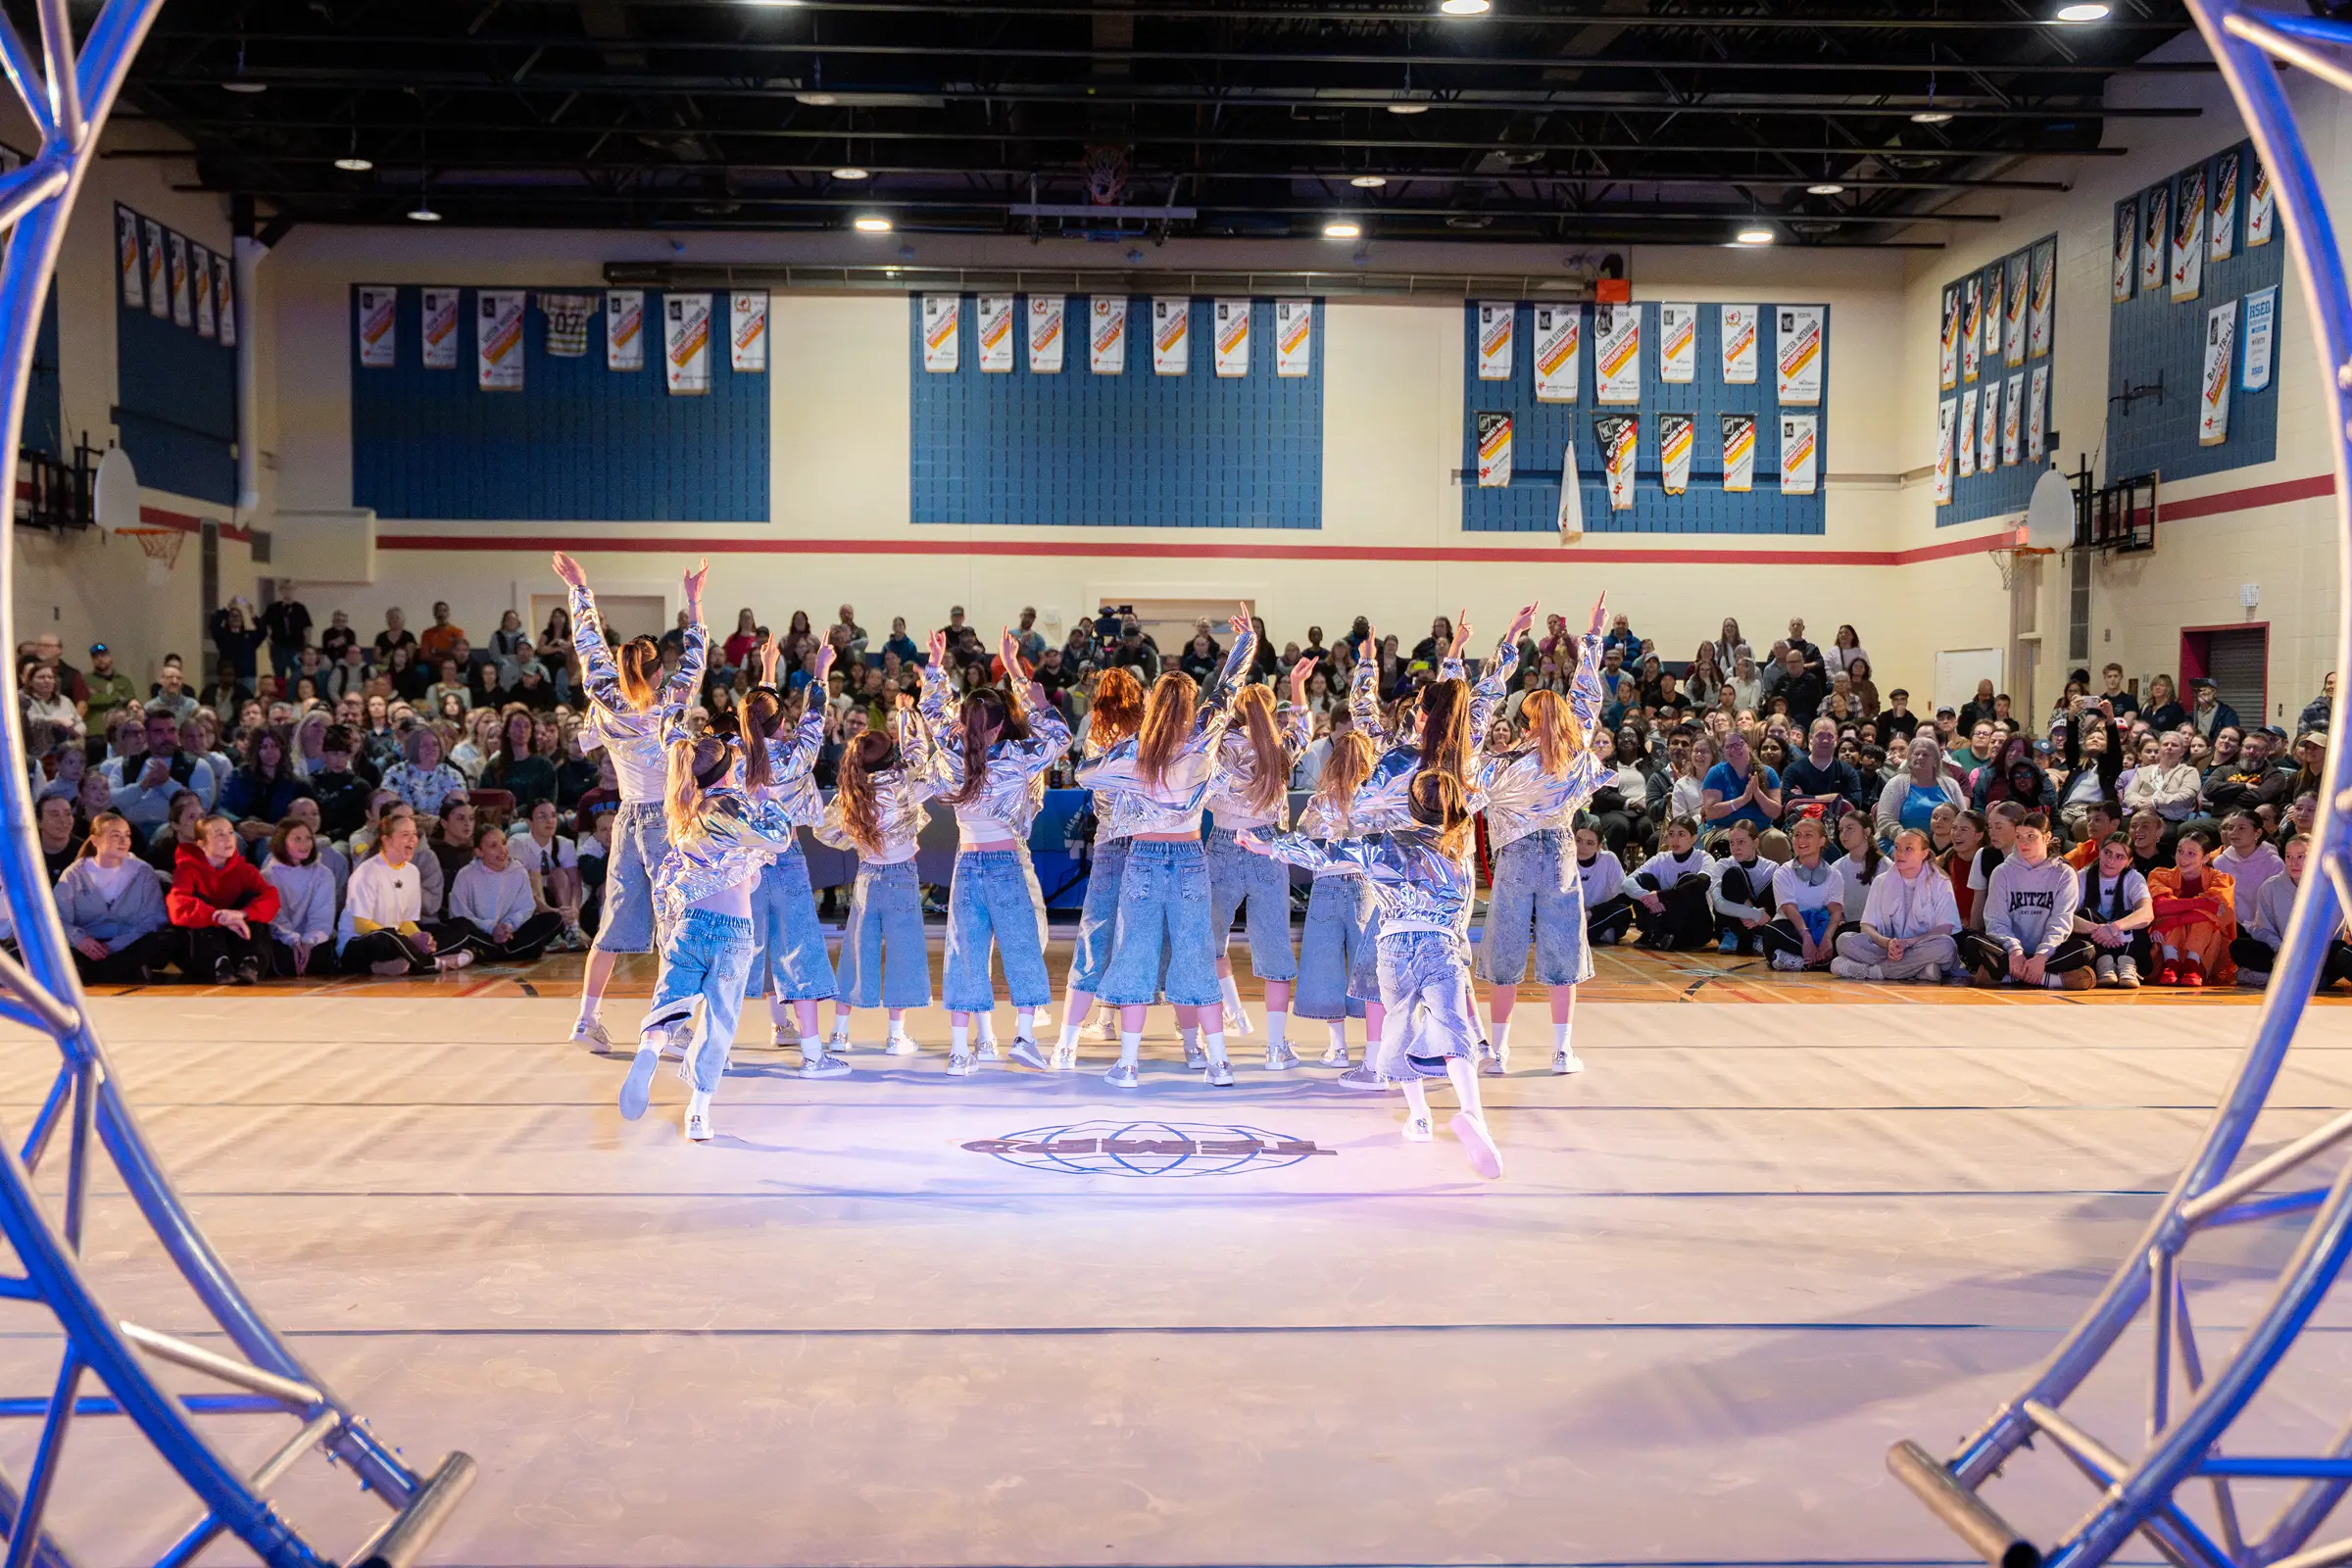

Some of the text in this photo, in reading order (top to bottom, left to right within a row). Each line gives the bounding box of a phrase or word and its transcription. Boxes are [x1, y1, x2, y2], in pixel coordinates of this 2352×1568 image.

[926, 305, 955, 334] BADMINTON
[981, 305, 1009, 334] BADMINTON
[1537, 337, 1554, 357] SOCCER
[1539, 332, 1575, 368] CHAMPIONNES
[1597, 339, 1614, 359] SOCCER
[1600, 334, 1637, 371] CHAMPIONS
[1780, 341, 1797, 359] SOCCER
[1781, 335, 1818, 372] CHAMPIONNES
[1480, 416, 1509, 444] BASKET-BALL
[1480, 425, 1509, 455] CHAMPIONS
[1661, 419, 1690, 447] BASKET-BALL
[1724, 419, 1752, 448] BASKET-BALL
[1724, 430, 1752, 459] CHAMPIONS
